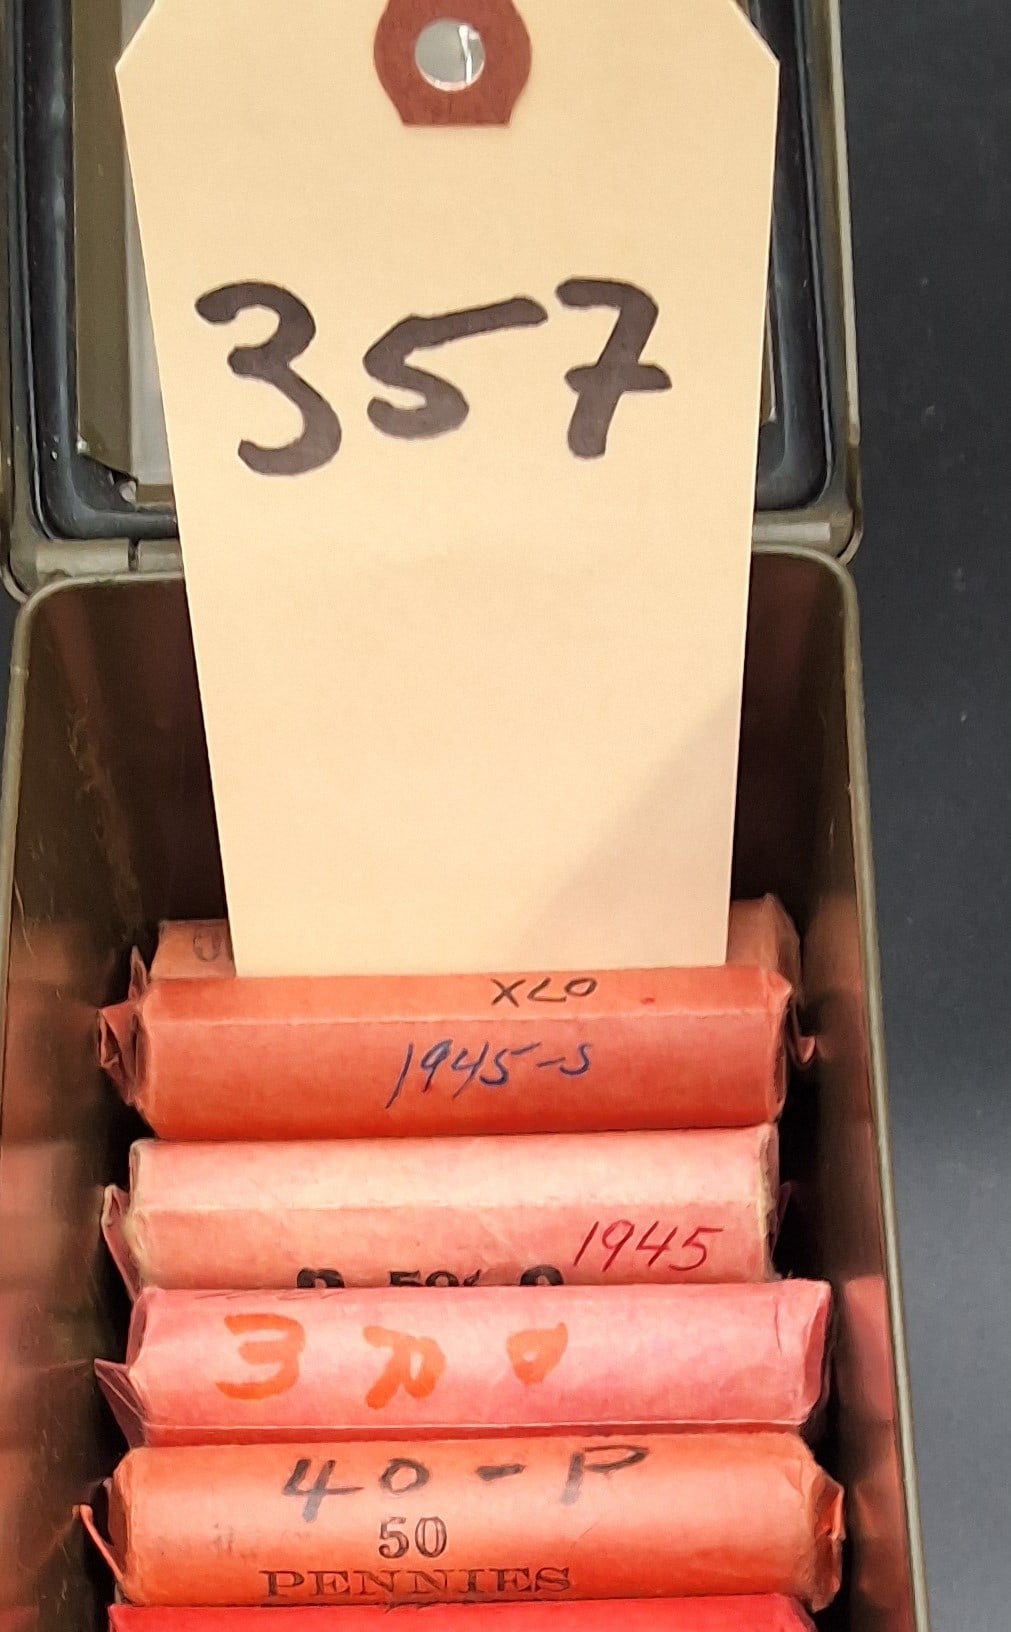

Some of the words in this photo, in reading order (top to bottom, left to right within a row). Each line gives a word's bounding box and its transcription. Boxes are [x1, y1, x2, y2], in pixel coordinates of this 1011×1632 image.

[195, 276, 671, 476] 357
[573, 1219, 724, 1273] 1945
[378, 1516, 448, 1560] 50
[259, 1565, 572, 1599] PENNIES
